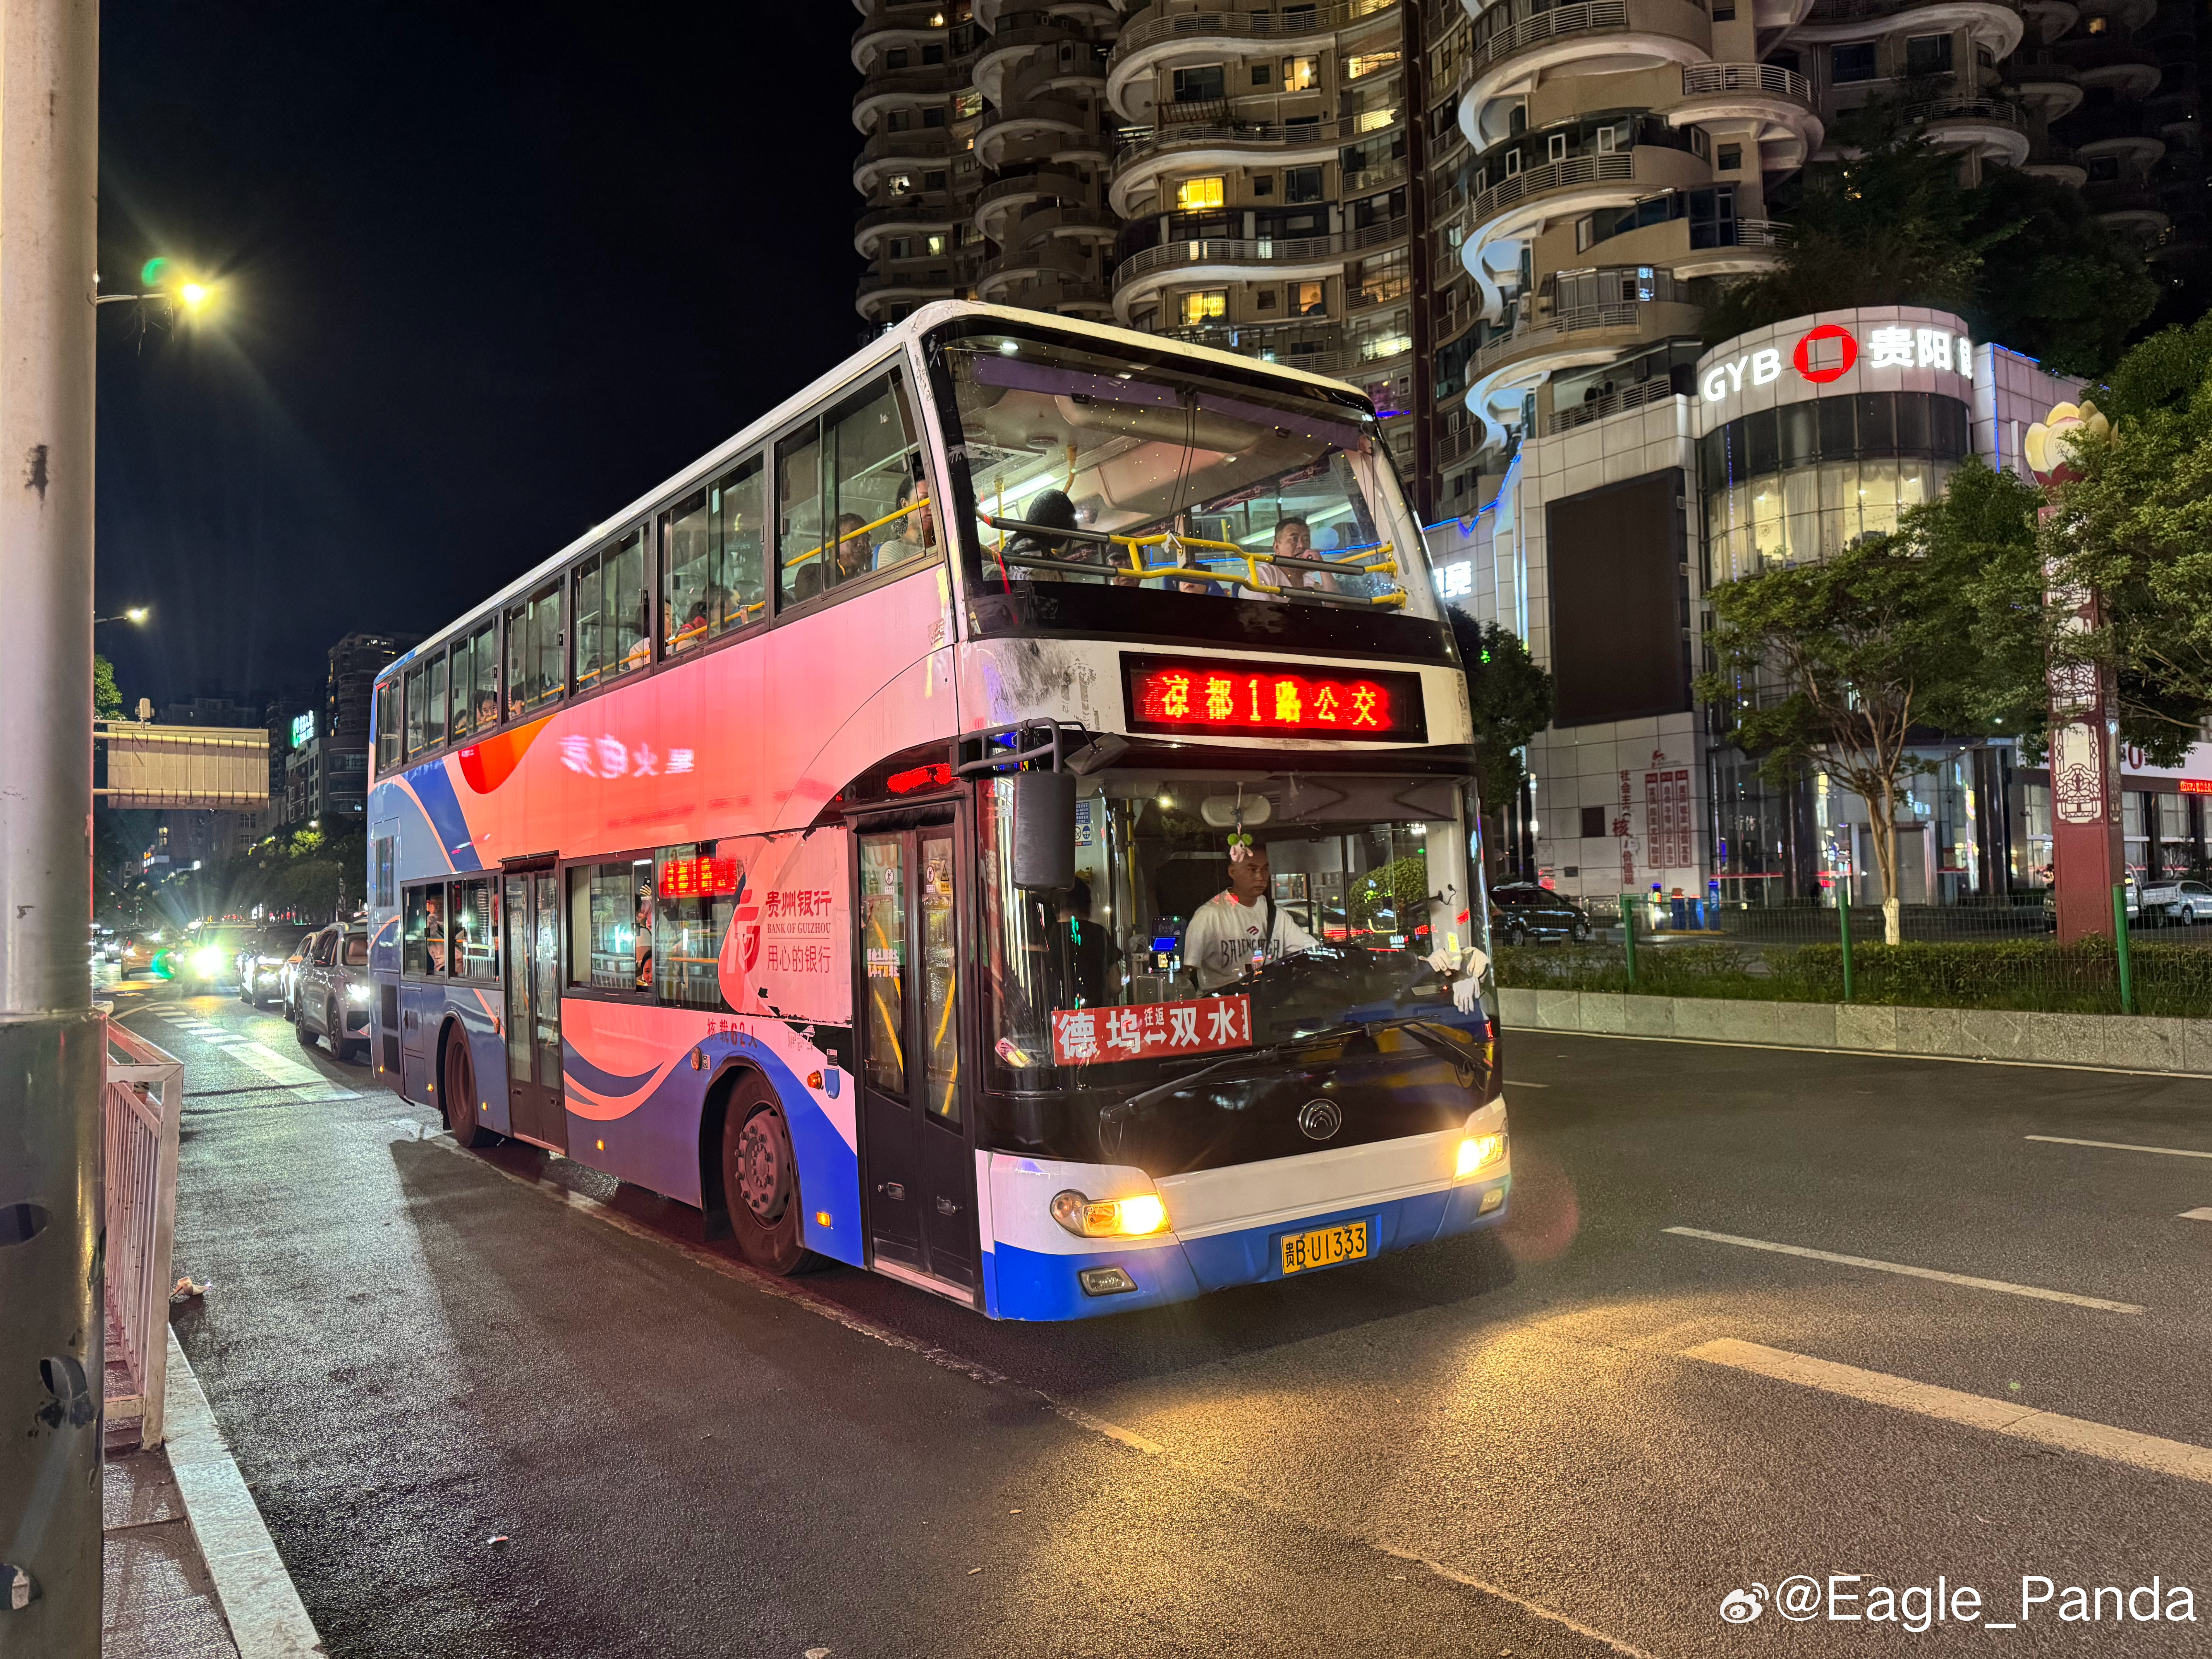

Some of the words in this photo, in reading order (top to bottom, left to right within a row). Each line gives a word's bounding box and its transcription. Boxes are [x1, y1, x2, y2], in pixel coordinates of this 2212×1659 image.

[1703, 348, 1781, 402] GYB
[765, 889, 832, 917] 贵州银行
[767, 923, 785, 934] BANK
[787, 923, 796, 934] OF
[797, 923, 831, 934] GUIZHOU
[767, 945, 831, 973] 用心的银行
[707, 1018, 758, 1049] 核载62人
